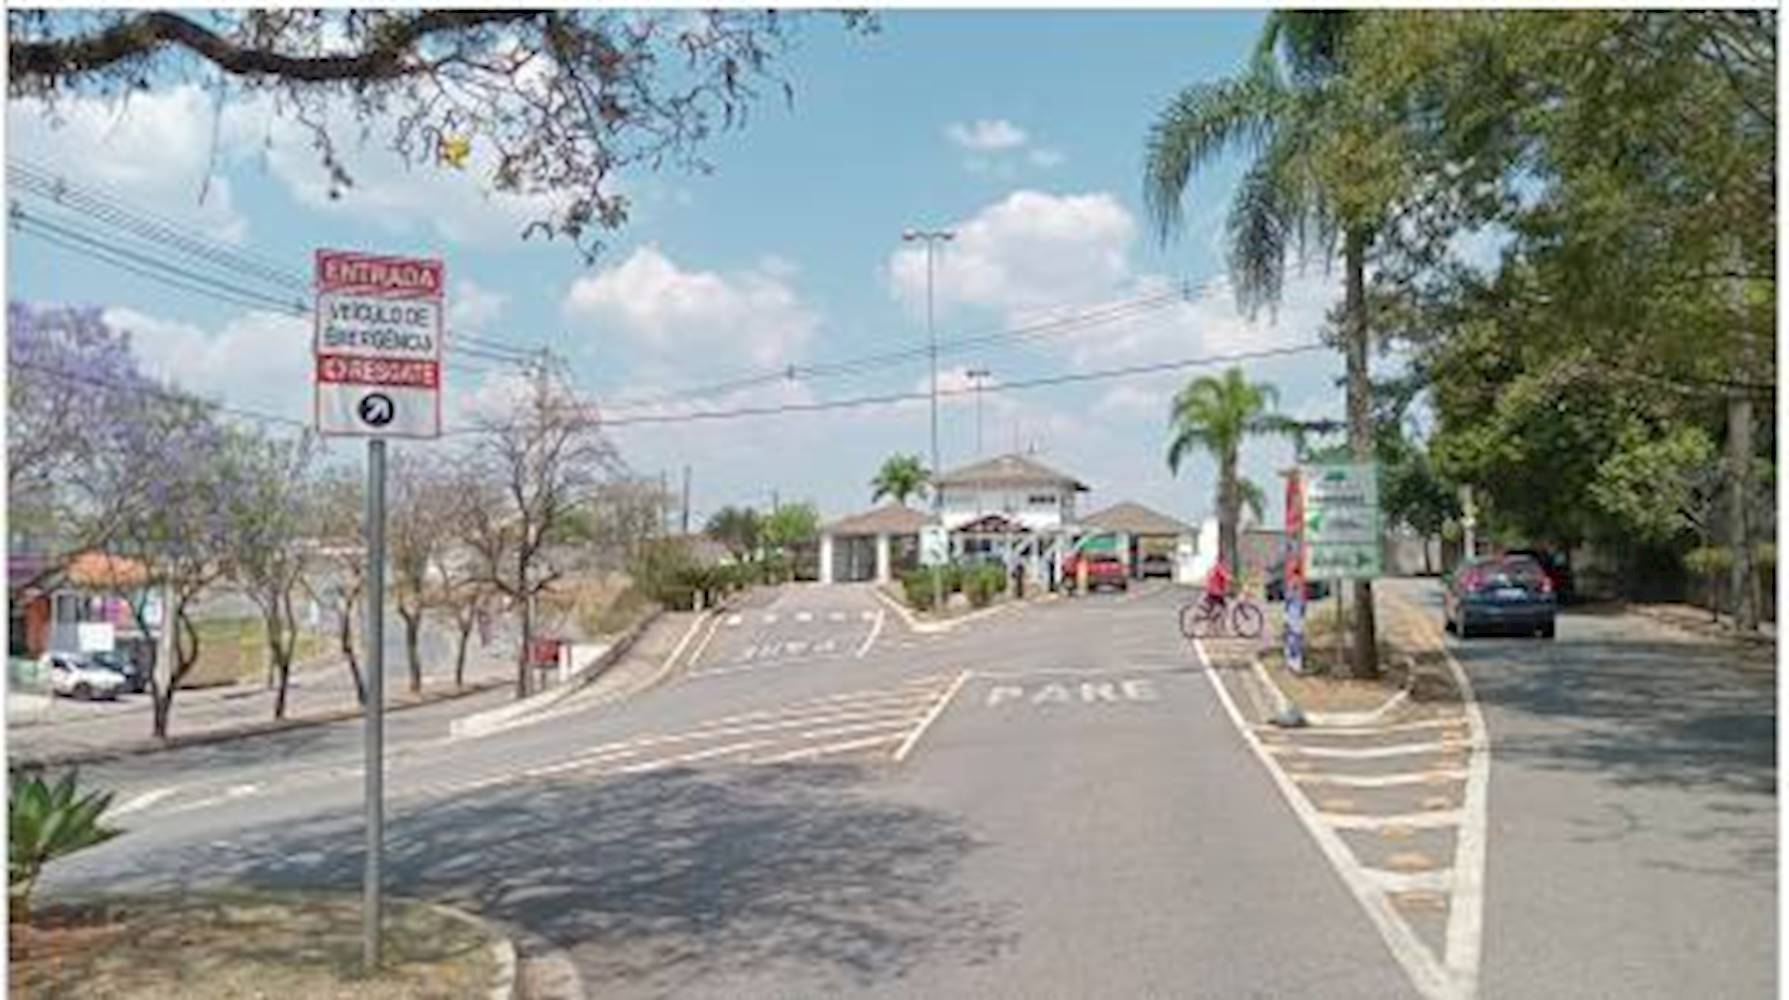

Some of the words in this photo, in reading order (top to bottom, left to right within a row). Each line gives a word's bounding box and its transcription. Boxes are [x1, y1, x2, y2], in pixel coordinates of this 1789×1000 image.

[324, 259, 435, 289] ENTRADA
[405, 306, 430, 328] DE
[347, 360, 436, 385] RESGATE
[985, 678, 1160, 708] PARE
